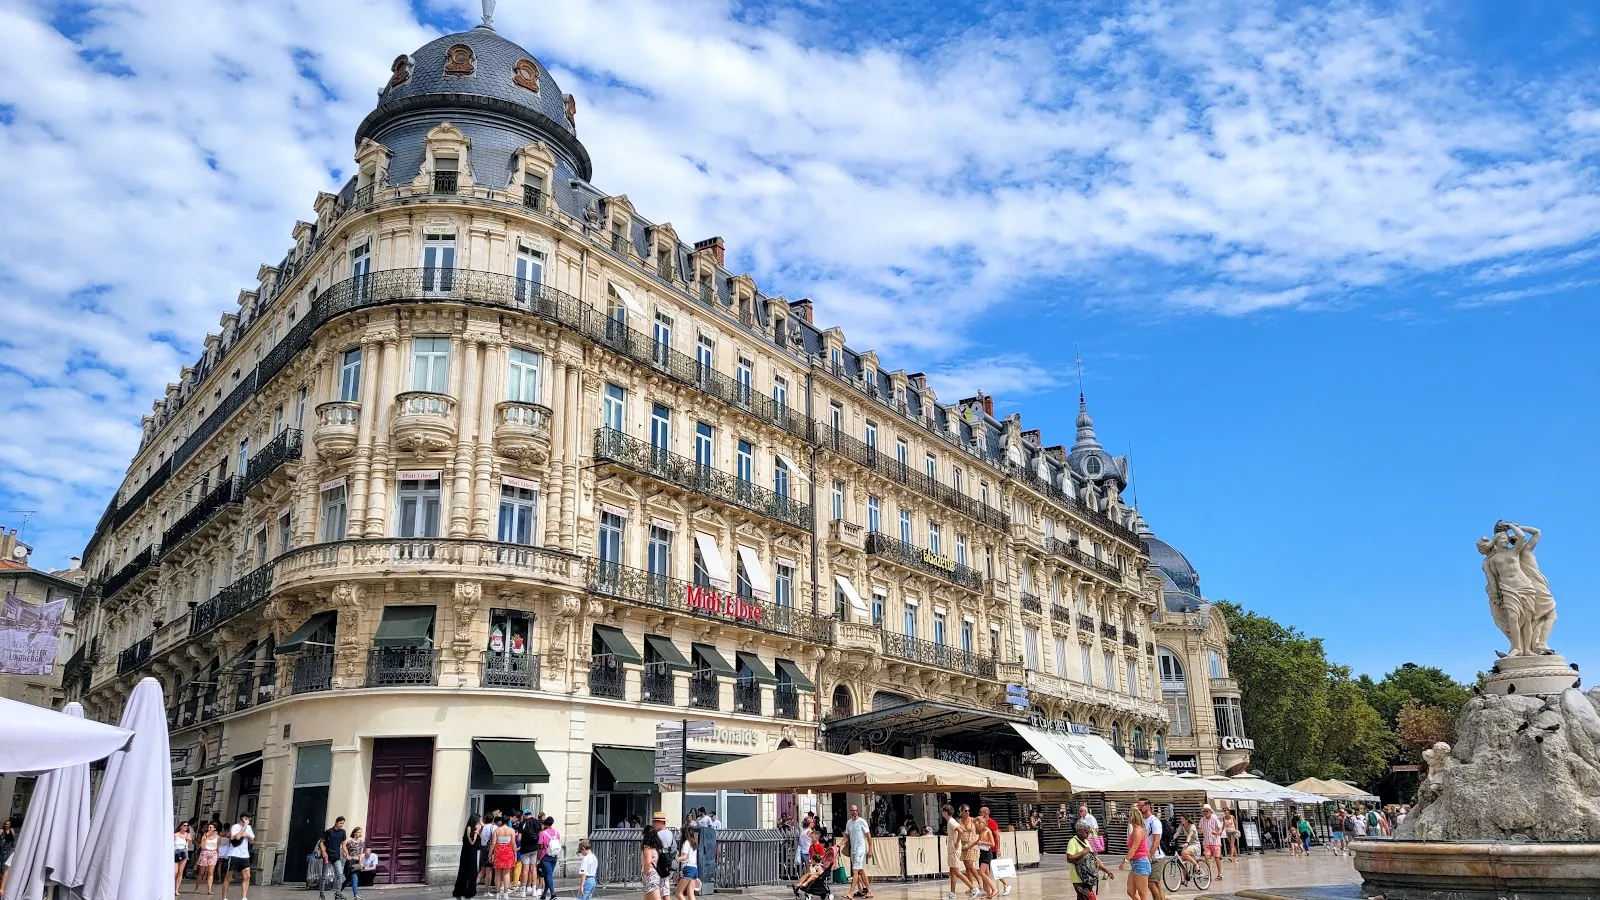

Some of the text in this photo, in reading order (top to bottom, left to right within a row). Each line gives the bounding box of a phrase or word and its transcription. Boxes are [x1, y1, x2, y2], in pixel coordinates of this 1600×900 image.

[686, 585, 763, 623] Midi Libre
[692, 727, 759, 745] Donald's
[1168, 757, 1197, 768] mont
